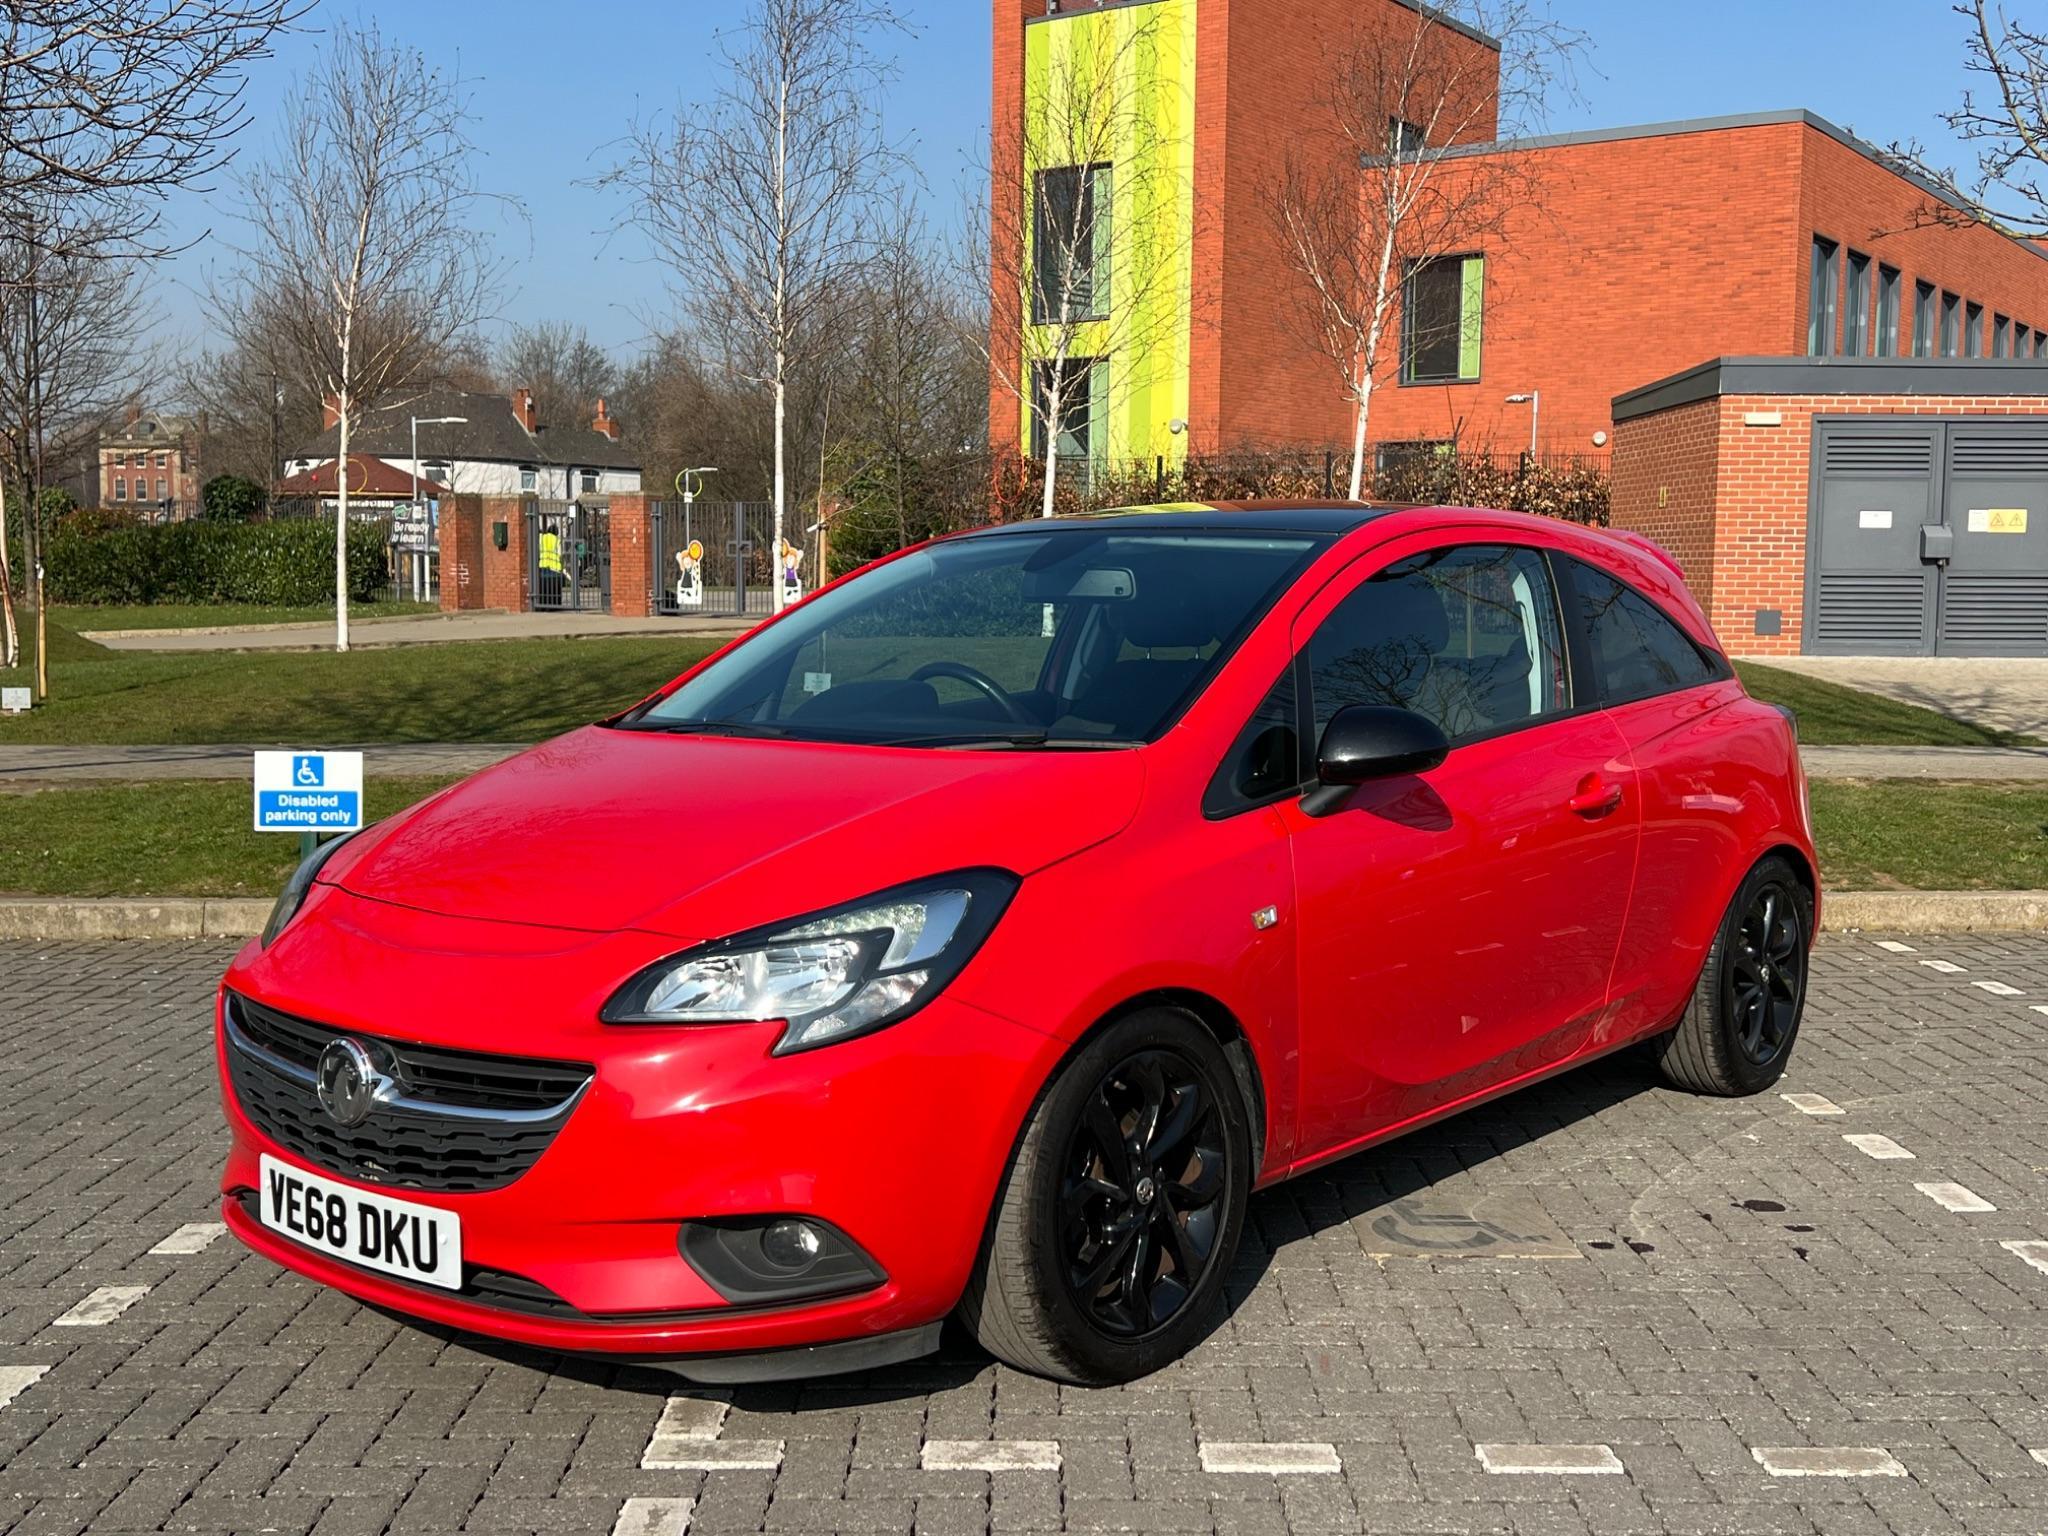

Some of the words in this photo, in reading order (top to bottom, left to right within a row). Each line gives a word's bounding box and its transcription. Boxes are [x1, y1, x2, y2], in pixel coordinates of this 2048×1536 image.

[404, 522, 430, 534] ready
[400, 533, 425, 543] learn
[278, 794, 339, 807] Disabled
[265, 809, 318, 824] parking
[321, 809, 351, 824] only
[269, 1168, 347, 1249] VE68
[358, 1201, 438, 1274] DKU
